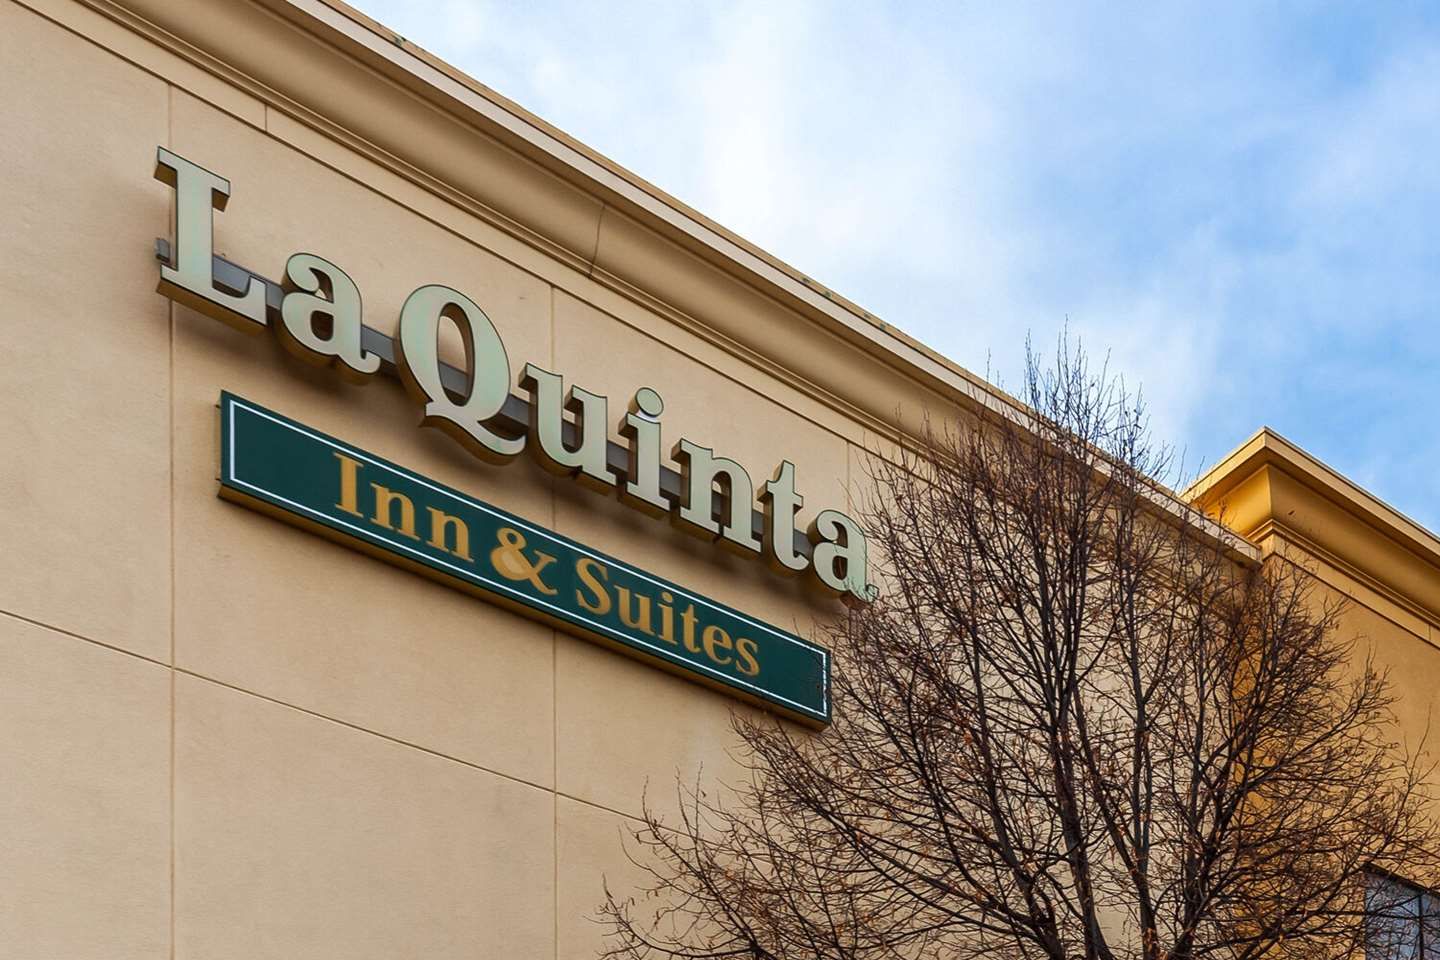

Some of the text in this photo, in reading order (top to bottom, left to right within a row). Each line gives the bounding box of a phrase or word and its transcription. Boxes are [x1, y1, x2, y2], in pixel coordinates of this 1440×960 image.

[156, 146, 879, 602] La Quinta
[333, 451, 761, 678] Inn & Suites
